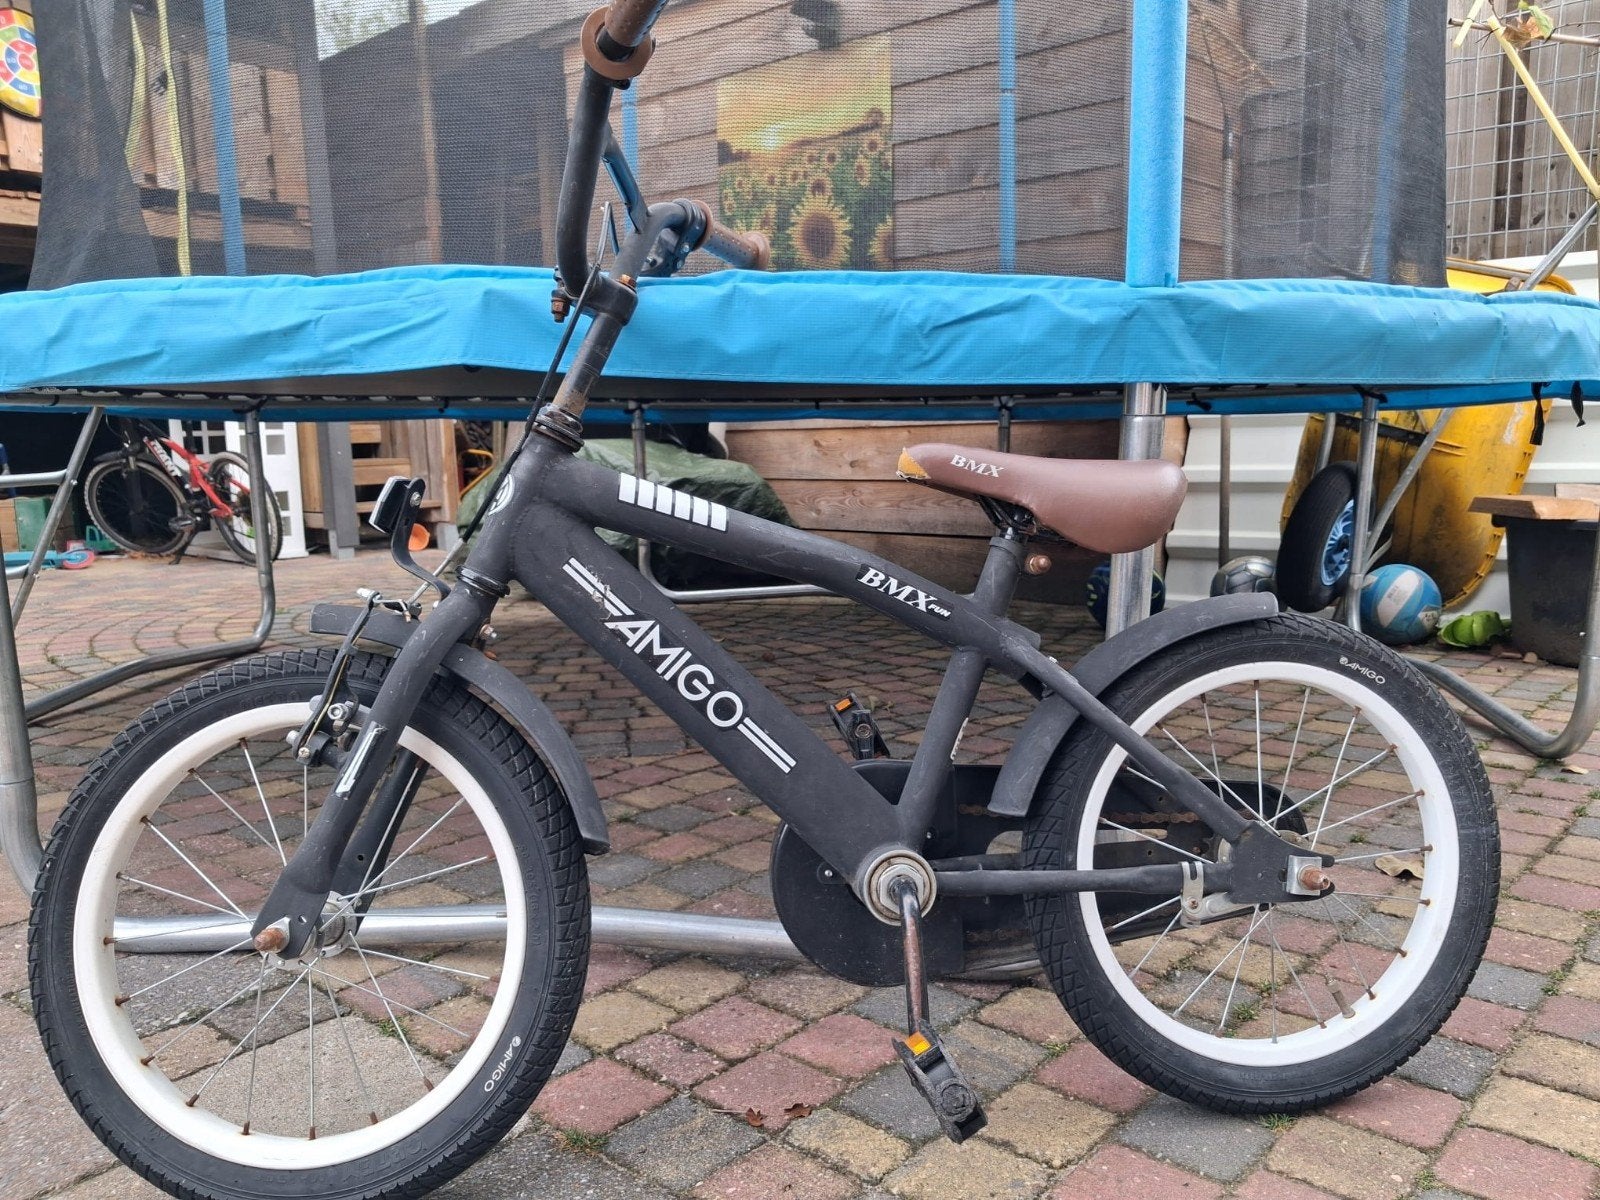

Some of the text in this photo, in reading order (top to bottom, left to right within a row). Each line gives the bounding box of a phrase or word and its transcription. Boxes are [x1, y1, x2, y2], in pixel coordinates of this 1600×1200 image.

[950, 454, 1004, 478] BMX
[857, 566, 952, 618] BMX FUN
[604, 618, 744, 728] AMIGO
[1345, 661, 1386, 685] AMIGO
[484, 1043, 513, 1092] AMIGO
